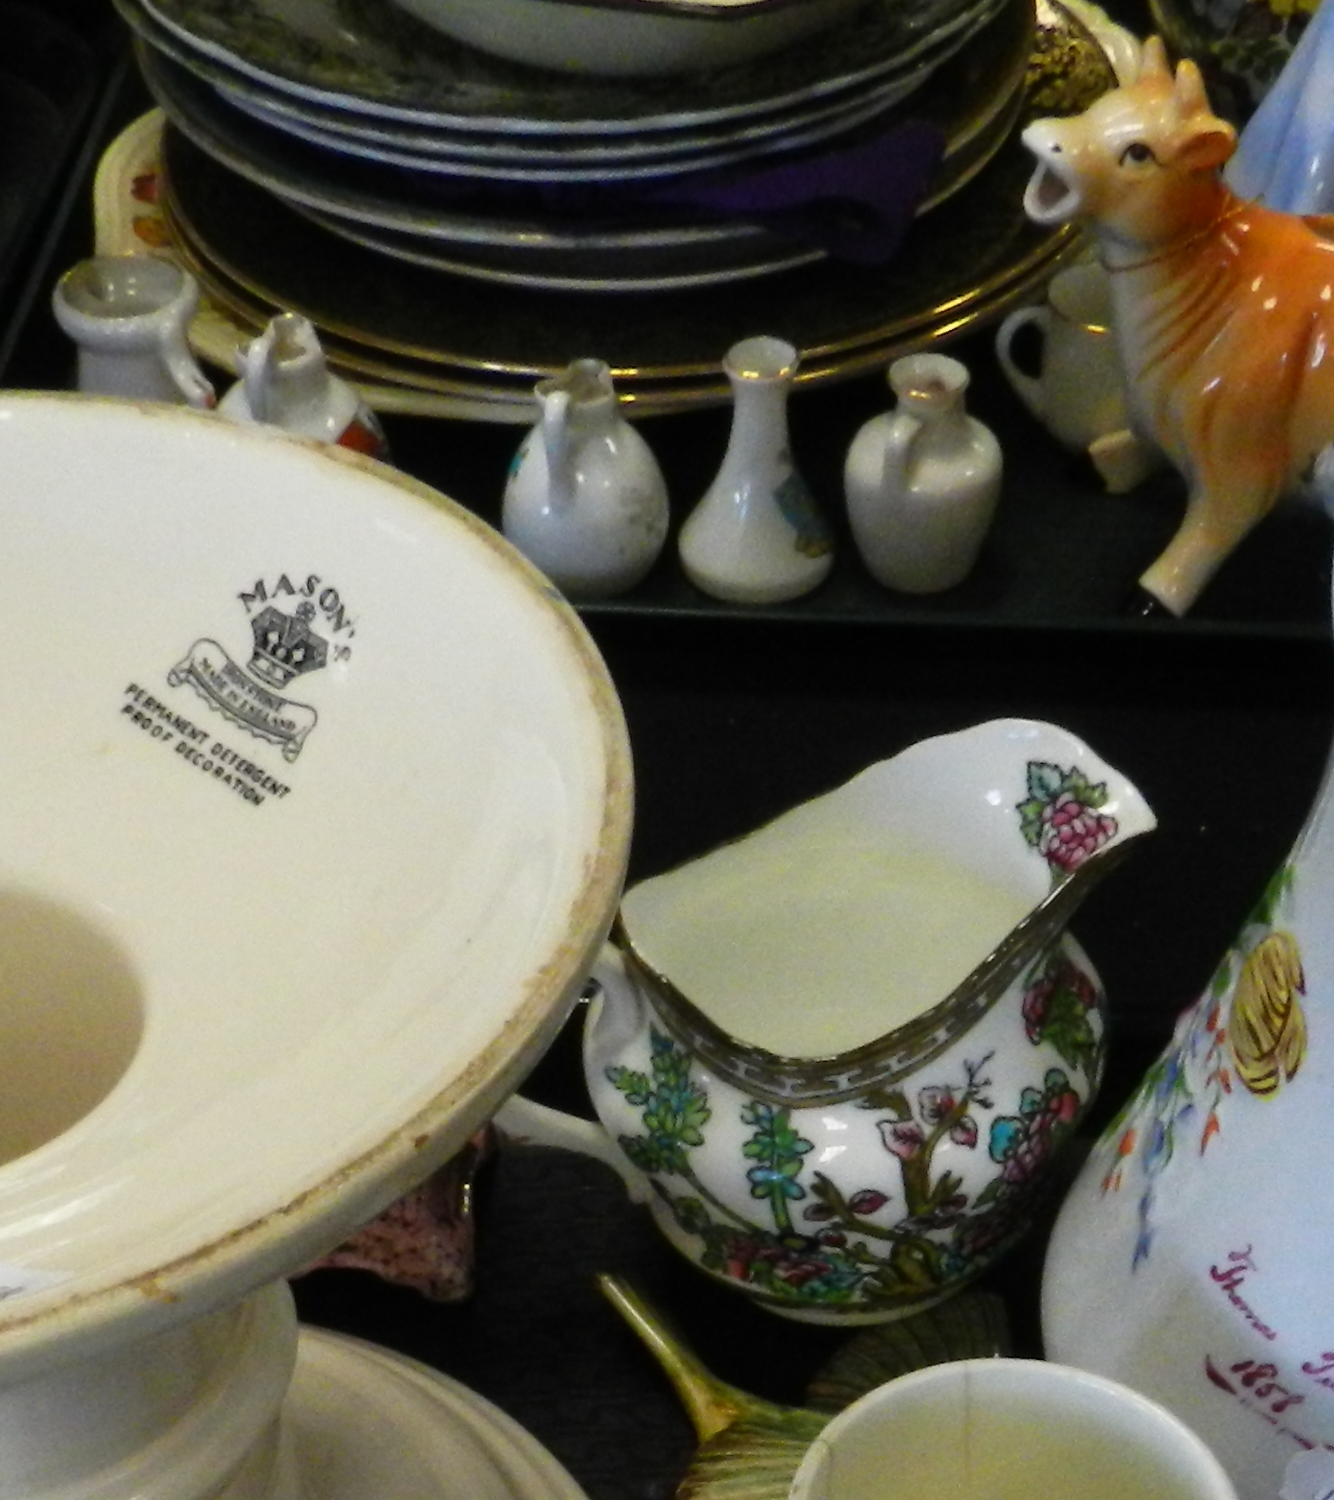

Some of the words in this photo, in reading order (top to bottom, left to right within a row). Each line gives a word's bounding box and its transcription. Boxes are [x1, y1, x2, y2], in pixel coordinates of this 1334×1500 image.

[121, 703, 174, 742] PROOF
[174, 740, 265, 806] DECORATION
[123, 681, 210, 744] PERMANENT
[210, 741, 292, 799] DETERGENT
